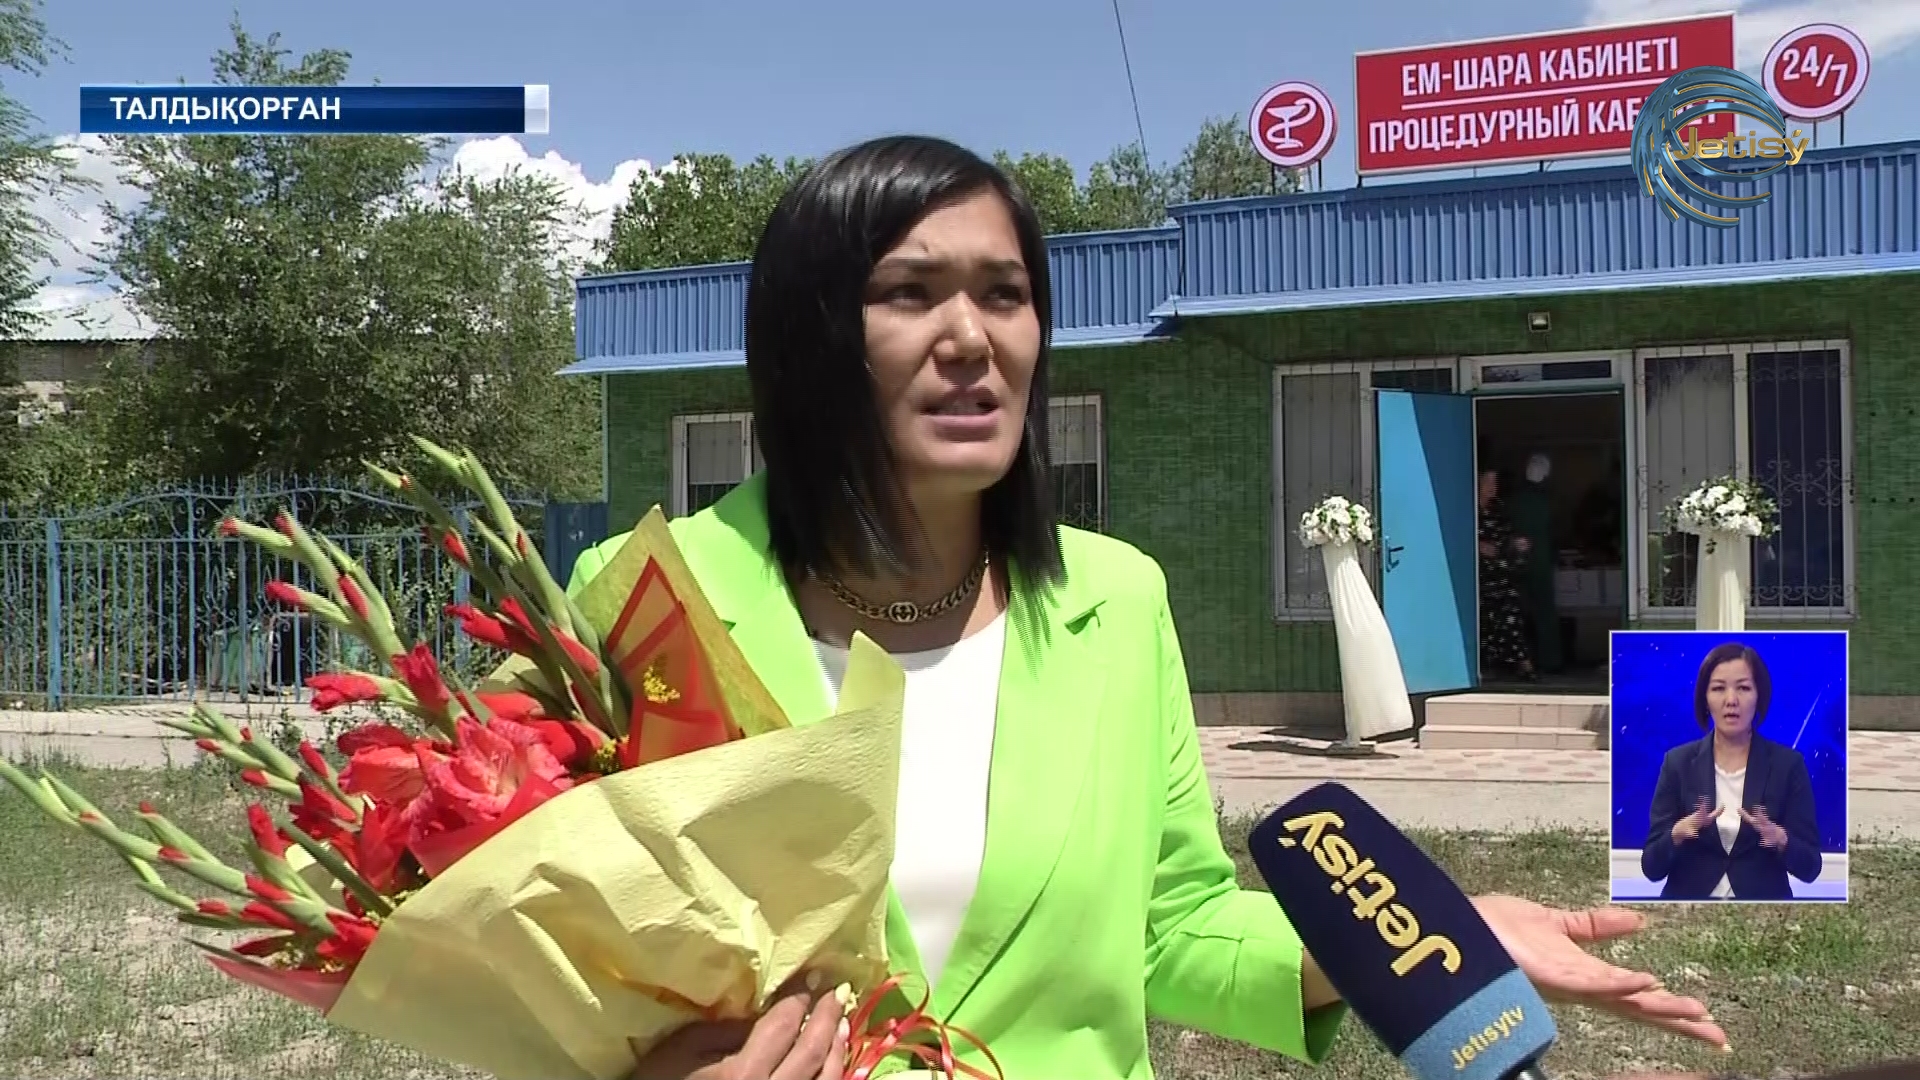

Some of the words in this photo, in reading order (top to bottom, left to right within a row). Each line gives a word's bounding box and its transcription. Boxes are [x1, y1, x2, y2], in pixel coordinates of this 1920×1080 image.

[1402, 53, 1532, 97] ЕМ-ШАРА
[1539, 37, 1678, 83] КАБИНЕТІ
[1782, 45, 1848, 96] 24/7
[1368, 98, 1580, 153] ПРОЦЕДУРНЫЙ
